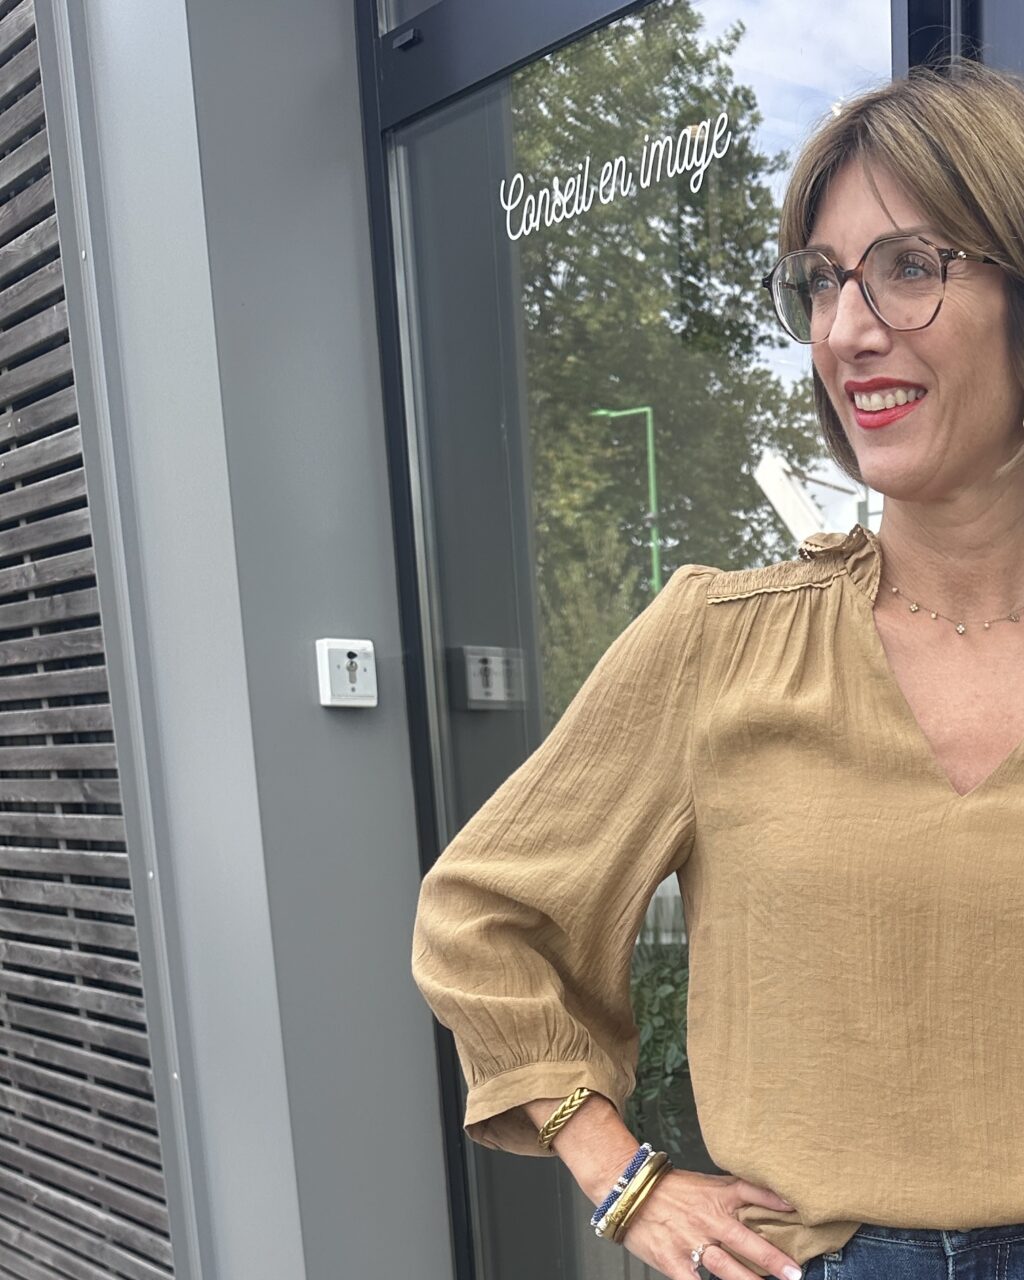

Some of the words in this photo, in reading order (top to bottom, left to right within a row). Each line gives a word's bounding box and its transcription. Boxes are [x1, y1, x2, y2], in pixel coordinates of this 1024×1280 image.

[500, 156, 595, 241] Conseil
[599, 155, 633, 205] en
[640, 112, 732, 193] image
